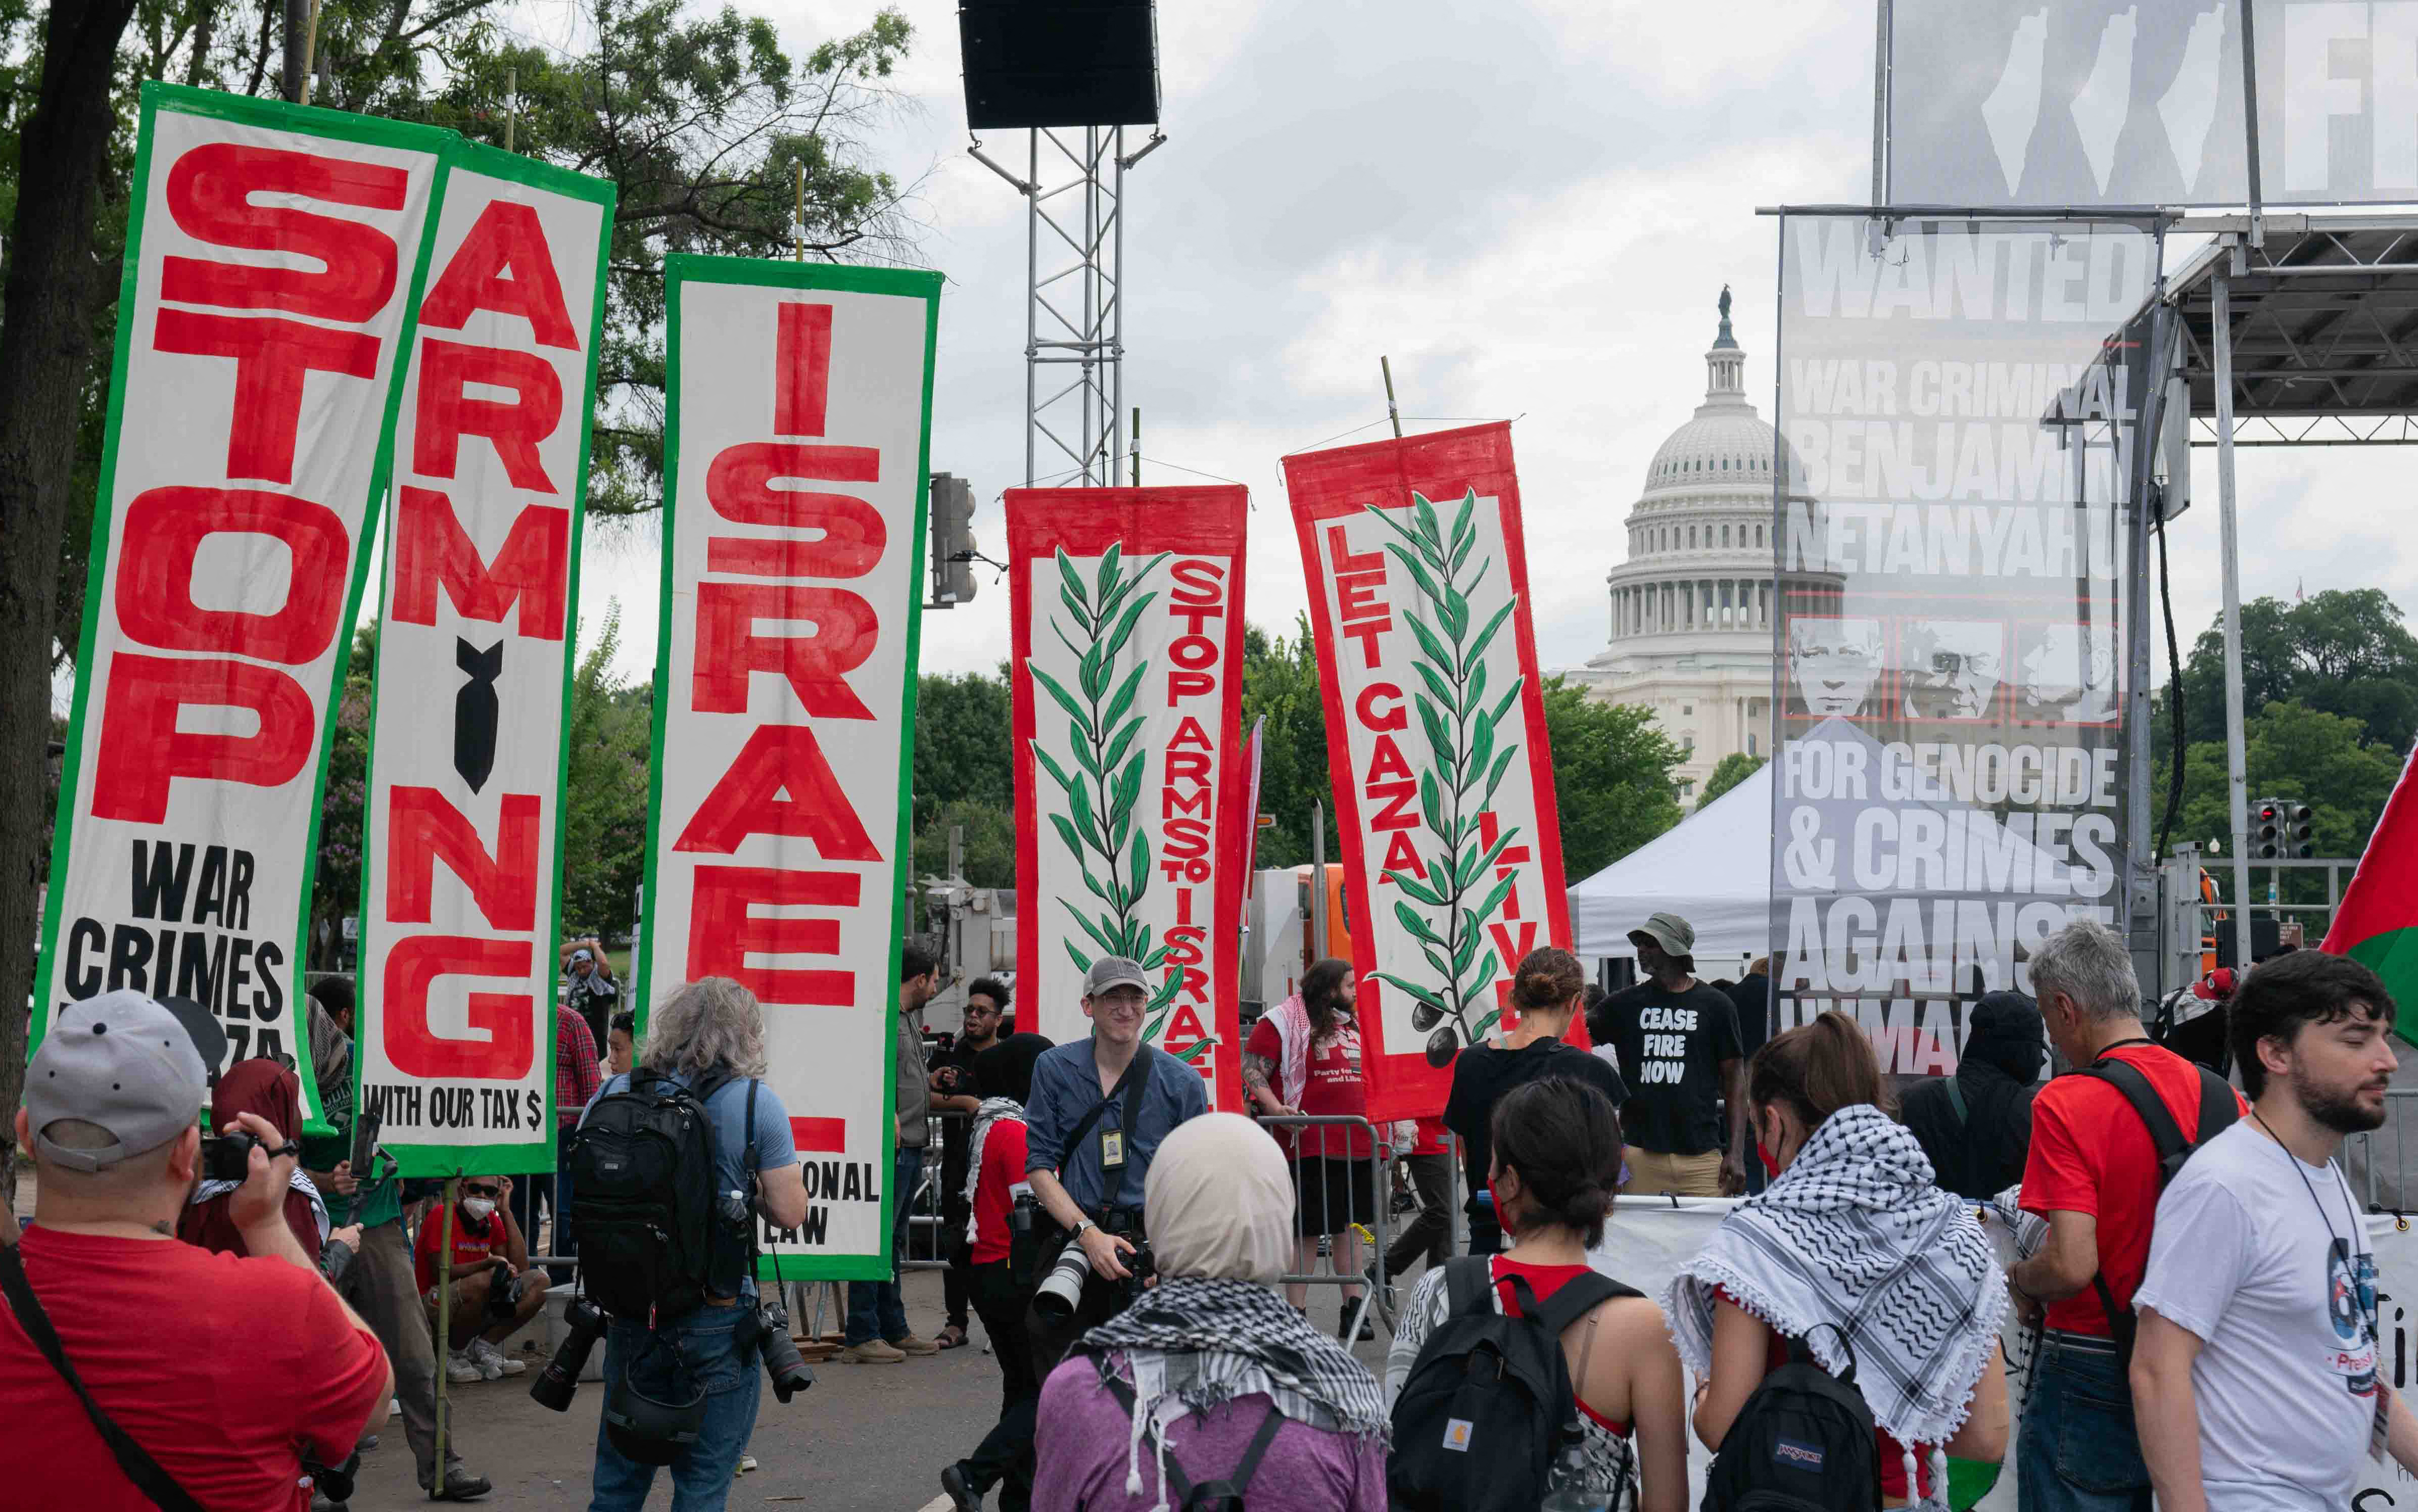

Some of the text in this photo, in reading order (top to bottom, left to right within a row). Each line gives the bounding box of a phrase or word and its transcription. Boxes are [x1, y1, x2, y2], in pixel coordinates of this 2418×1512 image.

[1795, 220, 2146, 322] WANTED
[1791, 359, 2137, 419] WAR CRIMINAL
[91, 143, 408, 824] STOP
[1788, 420, 2135, 504] BENJAMIN
[1786, 502, 2130, 580] NETANYAHU
[1167, 559, 1225, 707] STOP
[1326, 525, 1428, 884] LET GAZA
[1162, 716, 1214, 859] ARMS
[1784, 740, 2117, 808] FOR GENOCIDE
[132, 839, 255, 930] WAR
[1160, 858, 1211, 884] TO
[1783, 805, 2116, 898] & CRIMES
[65, 917, 283, 1022] CRIMES
[1640, 1008, 1698, 1031] CEASE
[1643, 1034, 1686, 1057] FIRE
[363, 1084, 421, 1126] WITH
[429, 1086, 475, 1128] OUR
[481, 1088, 520, 1129] TAX
[527, 1090, 542, 1131] $
[1314, 1069, 1339, 1077] Party
[1641, 1061, 1685, 1084] NOW
